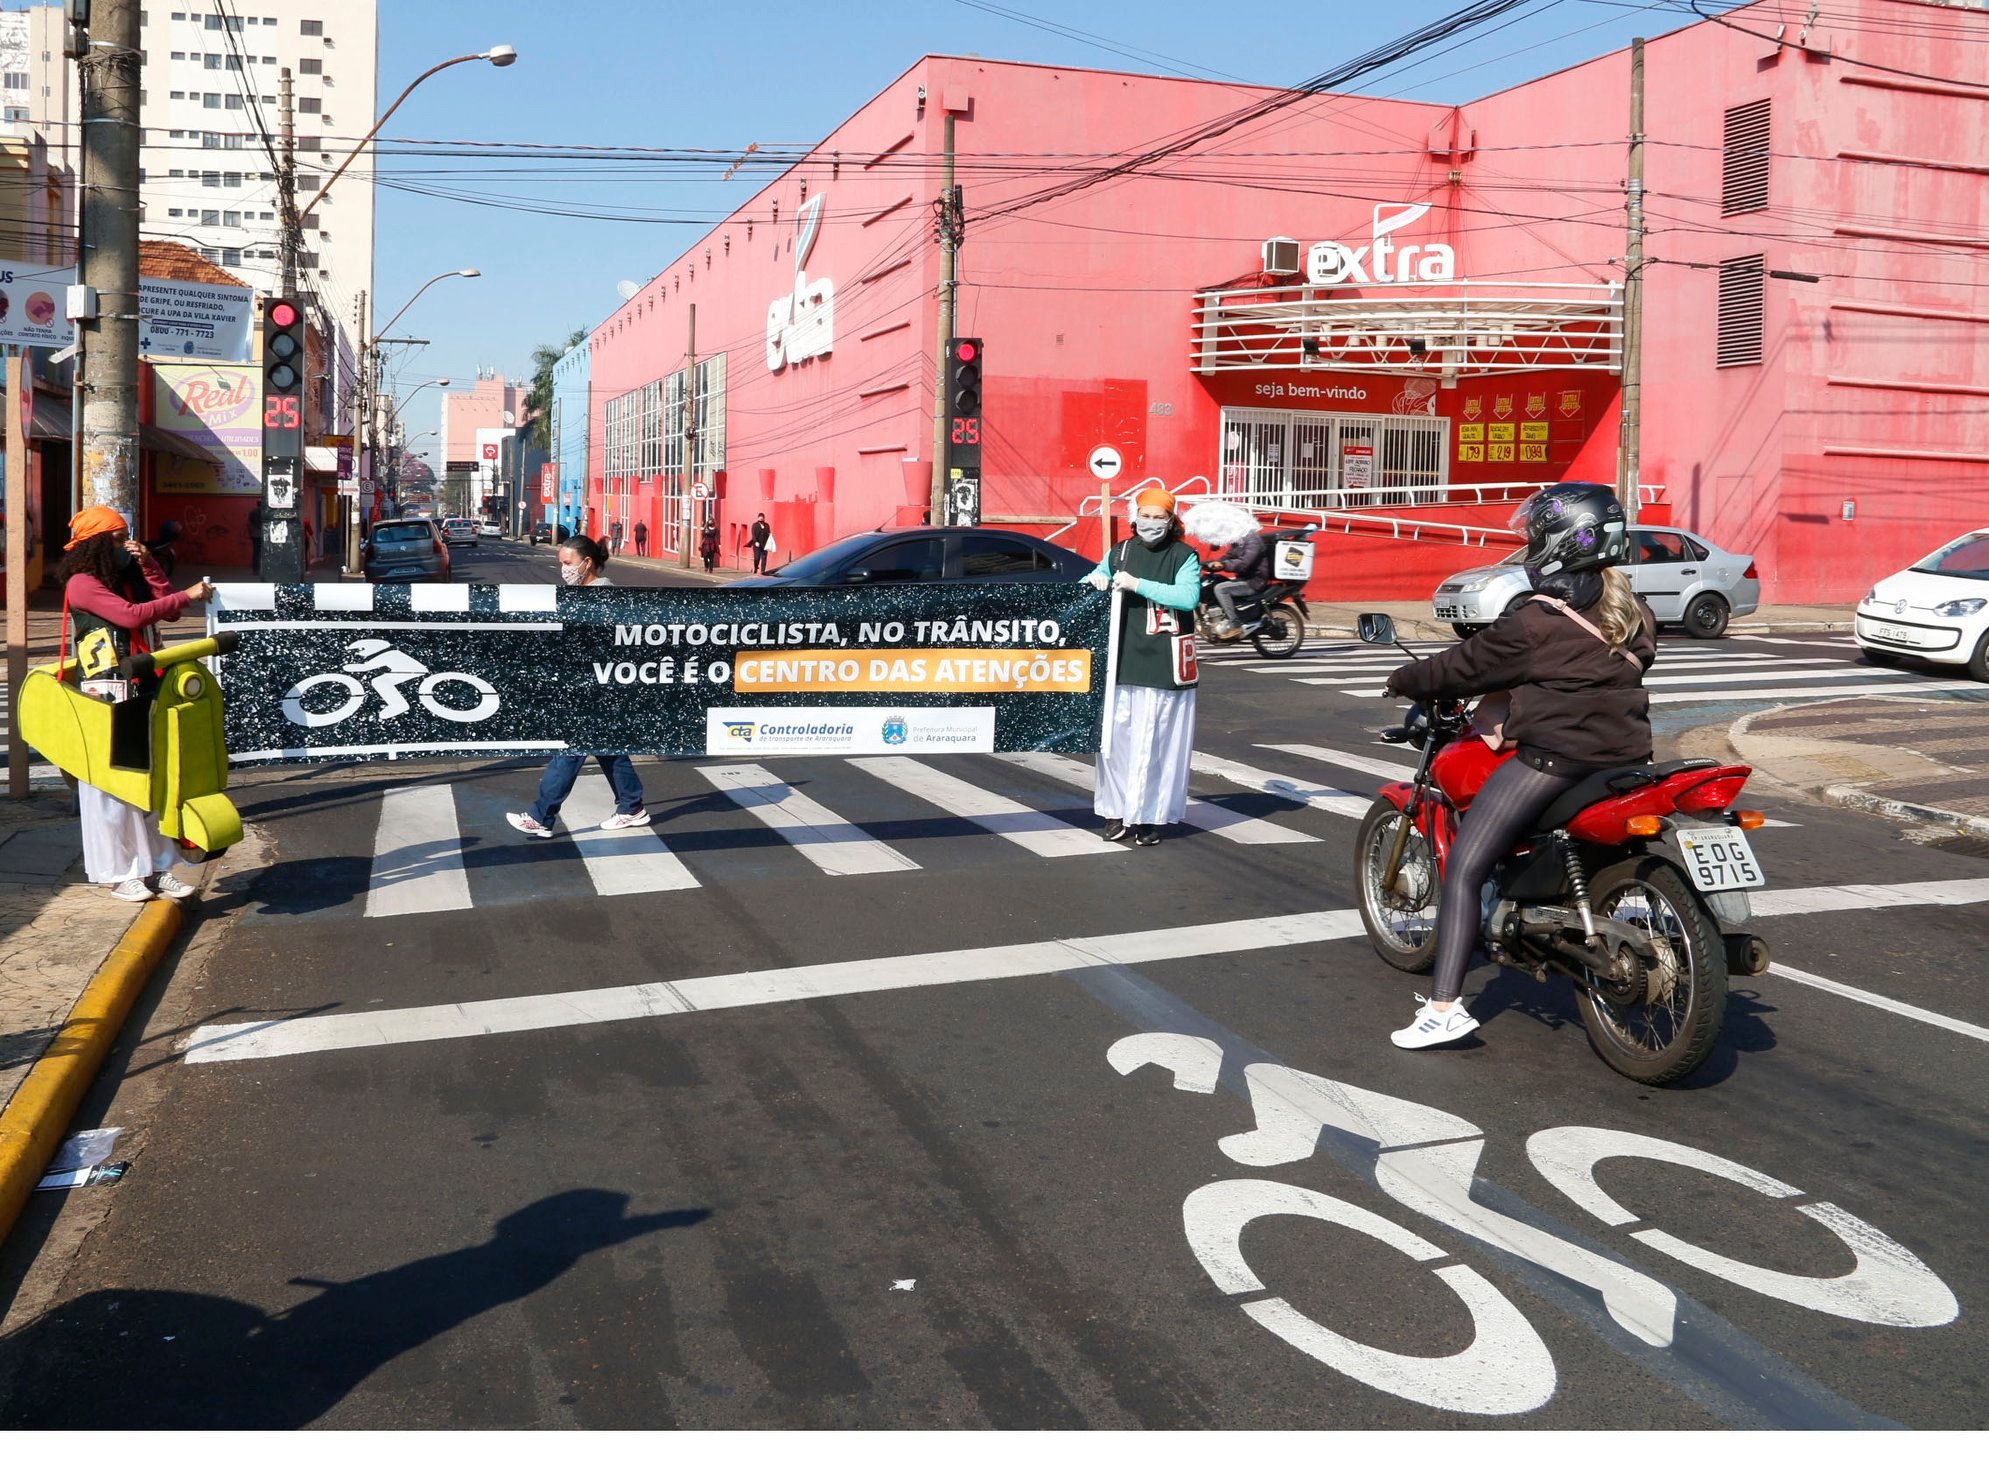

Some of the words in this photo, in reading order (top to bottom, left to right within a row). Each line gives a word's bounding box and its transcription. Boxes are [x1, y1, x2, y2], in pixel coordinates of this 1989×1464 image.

[1307, 228, 1455, 284] extra
[138, 285, 176, 295] APRESENTE
[178, 289, 216, 299] QUALQUER
[217, 294, 249, 303] SINTOMA
[150, 297, 172, 306] GRIPE,
[186, 300, 224, 311] RESFRIADO,
[168, 309, 181, 317] UPA
[212, 314, 236, 322] XAVIER
[150, 326, 169, 335] 0800
[176, 328, 189, 336] 771
[196, 330, 214, 338] 7723
[178, 376, 248, 416] Real
[1256, 382, 1284, 398] seja
[1288, 383, 1367, 400] bem-vindo
[264, 396, 300, 428] 25
[952, 418, 979, 444] 25
[614, 622, 847, 646] MOTOCICLISTA,
[858, 621, 904, 643] NO
[914, 615, 1066, 646] TRÂNSITO,
[592, 656, 675, 684] VOCÊ
[684, 656, 699, 684] É
[707, 661, 730, 684] O
[740, 660, 860, 683] CENTRO
[868, 659, 927, 682] DAS
[934, 654, 1084, 689] ATENÇÕES
[731, 726, 752, 736] cta
[760, 724, 853, 734] Controladoria
[926, 735, 976, 743] Araraquara
[1693, 842, 1745, 864] EOG
[1698, 863, 1757, 886] 9715
